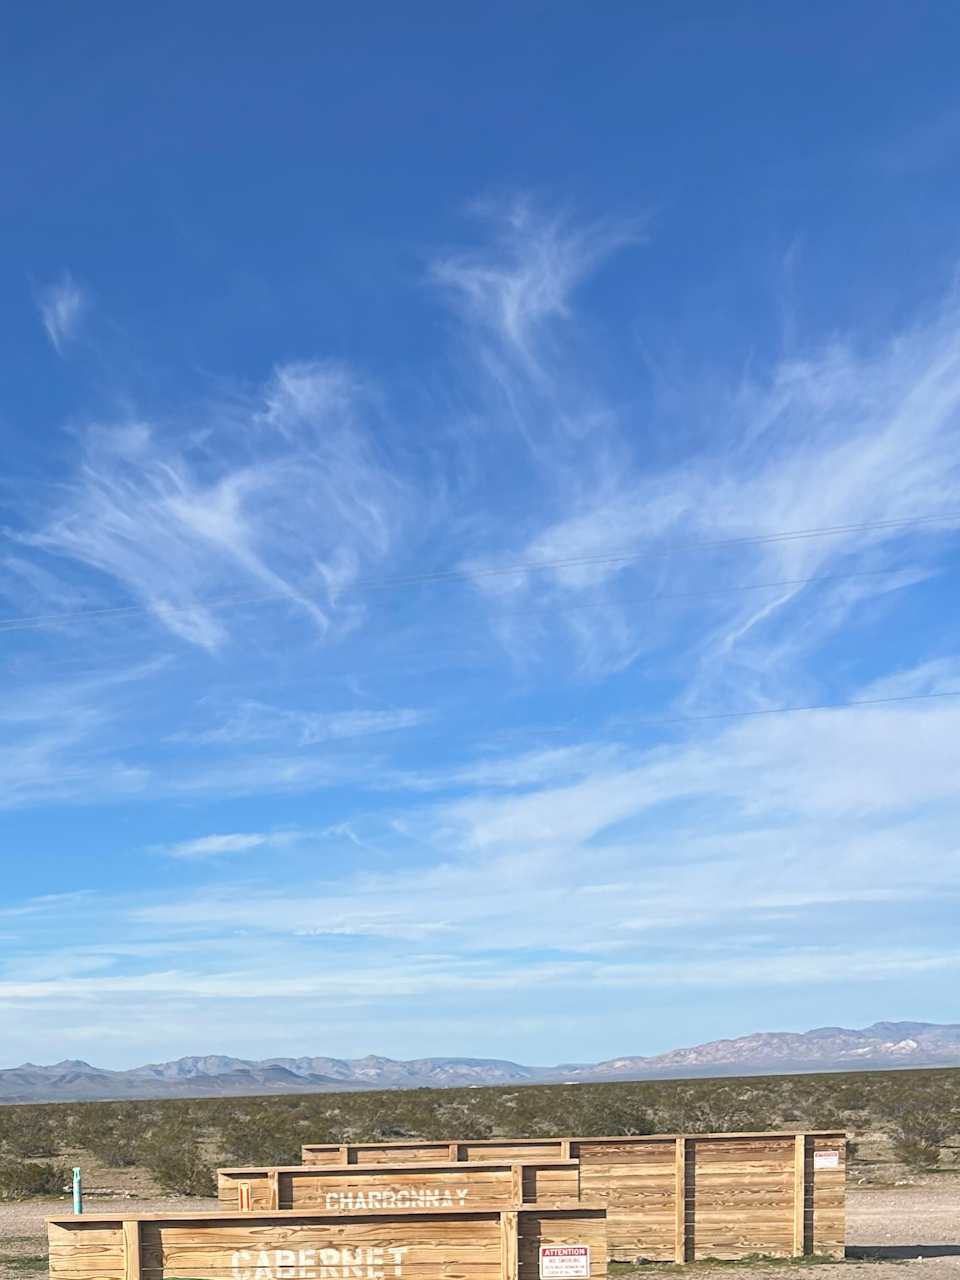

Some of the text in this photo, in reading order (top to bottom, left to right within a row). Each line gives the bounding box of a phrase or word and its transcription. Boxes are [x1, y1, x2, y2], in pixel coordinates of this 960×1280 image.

[326, 1188, 468, 1209] CHARDONNAY
[543, 1248, 587, 1256] ATTENTION
[231, 1248, 407, 1280] CABERNET
